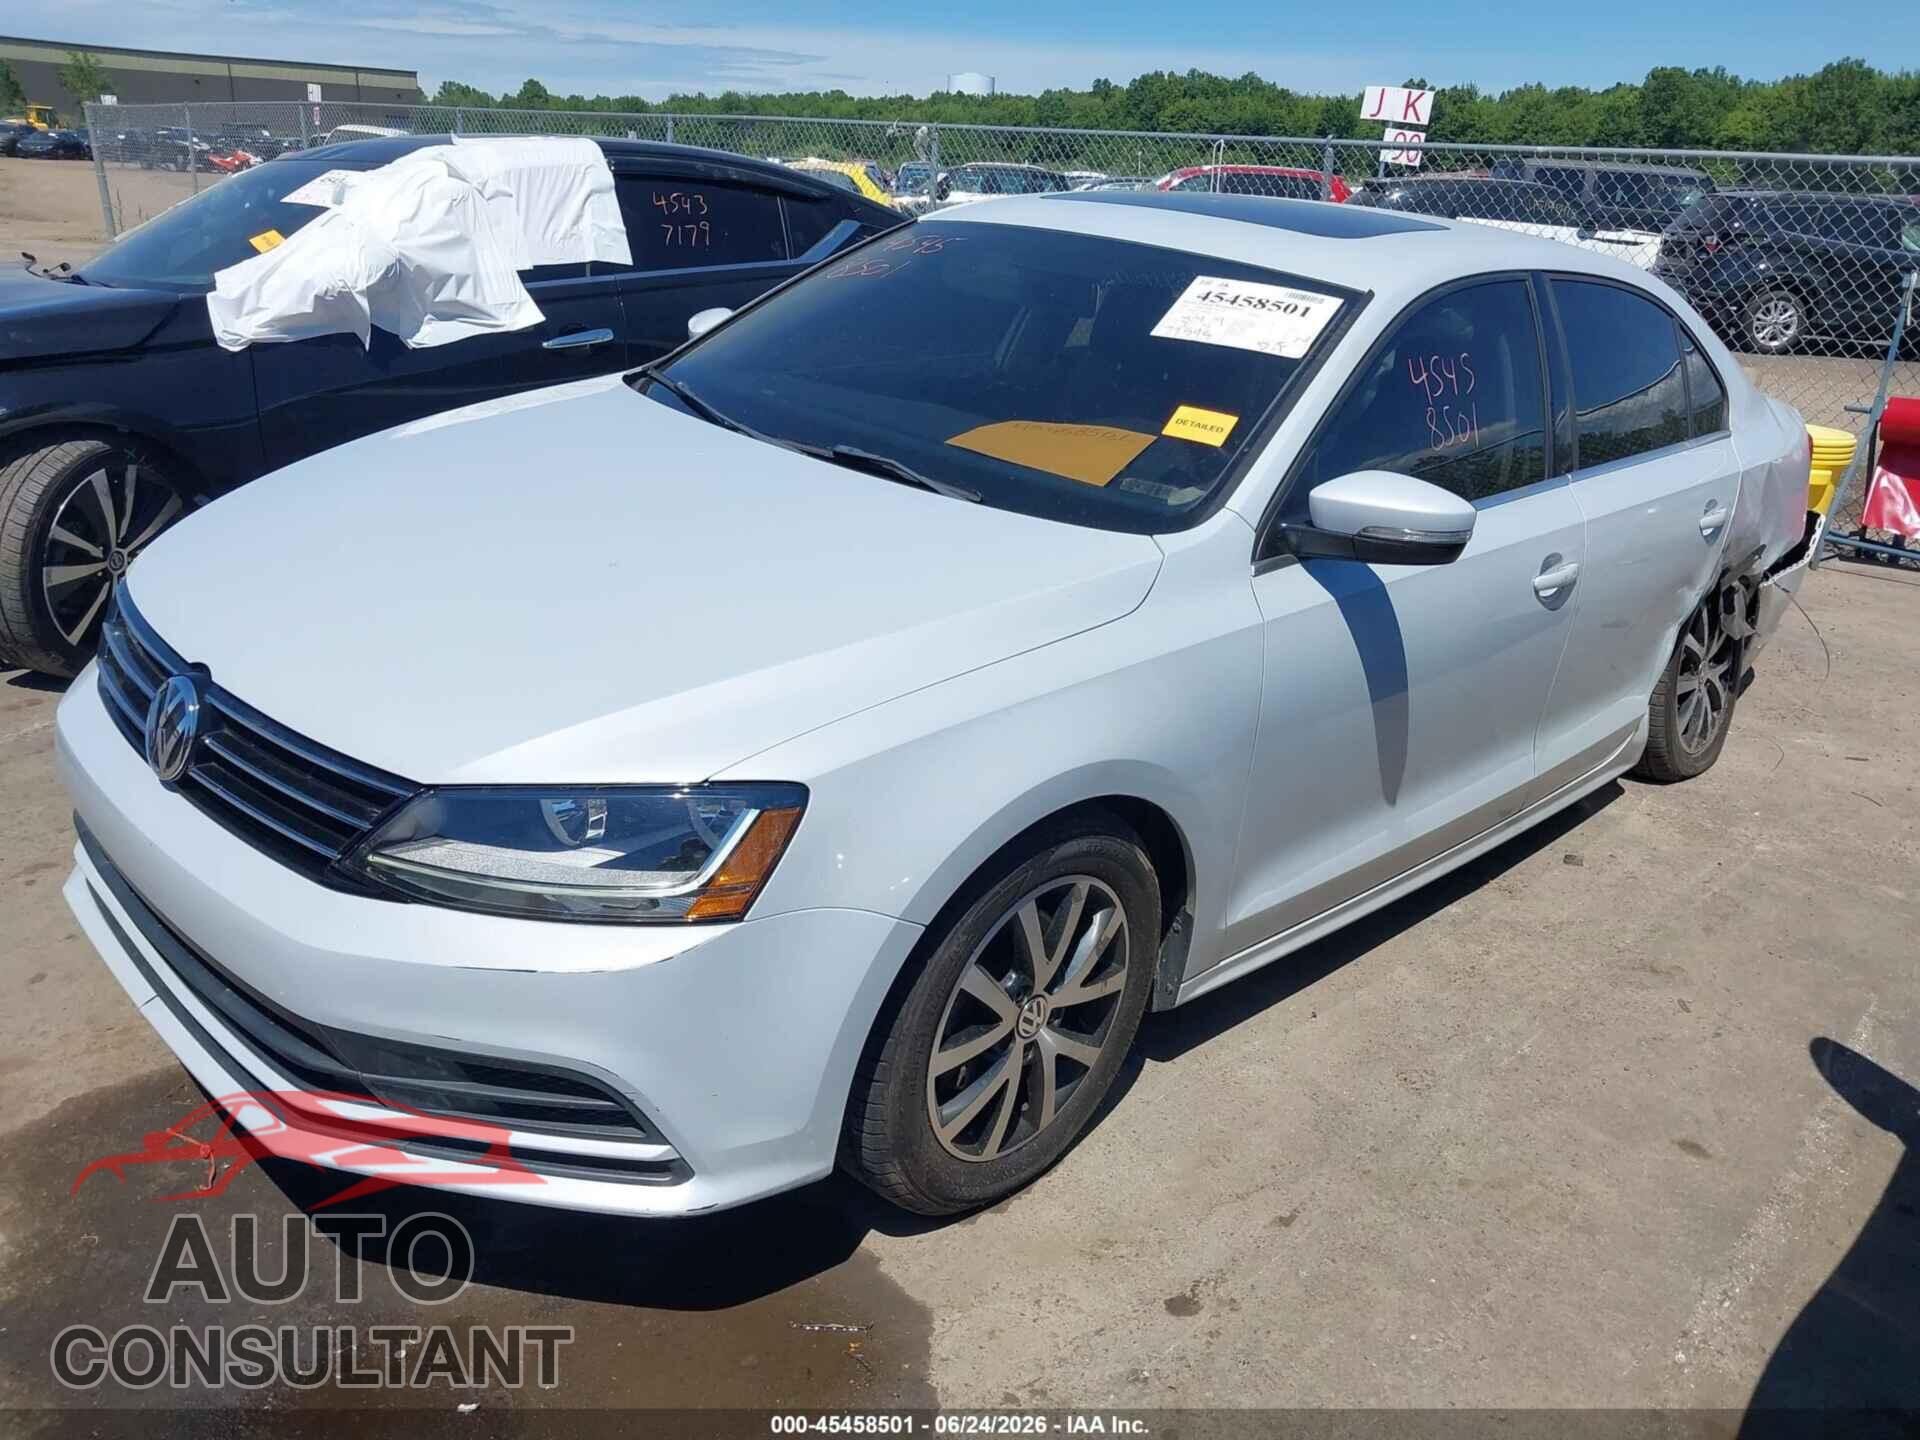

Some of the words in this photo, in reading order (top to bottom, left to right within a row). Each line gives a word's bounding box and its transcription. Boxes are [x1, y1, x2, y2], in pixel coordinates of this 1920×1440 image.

[1369, 88, 1385, 117] J
[1403, 90, 1426, 122] K
[652, 191, 708, 215] 4543
[661, 221, 710, 247] 7179
[1196, 289, 1311, 318] 45458501
[1408, 352, 1475, 405] 4545
[1175, 418, 1224, 433] DETAILED
[1426, 400, 1479, 451] 8501
